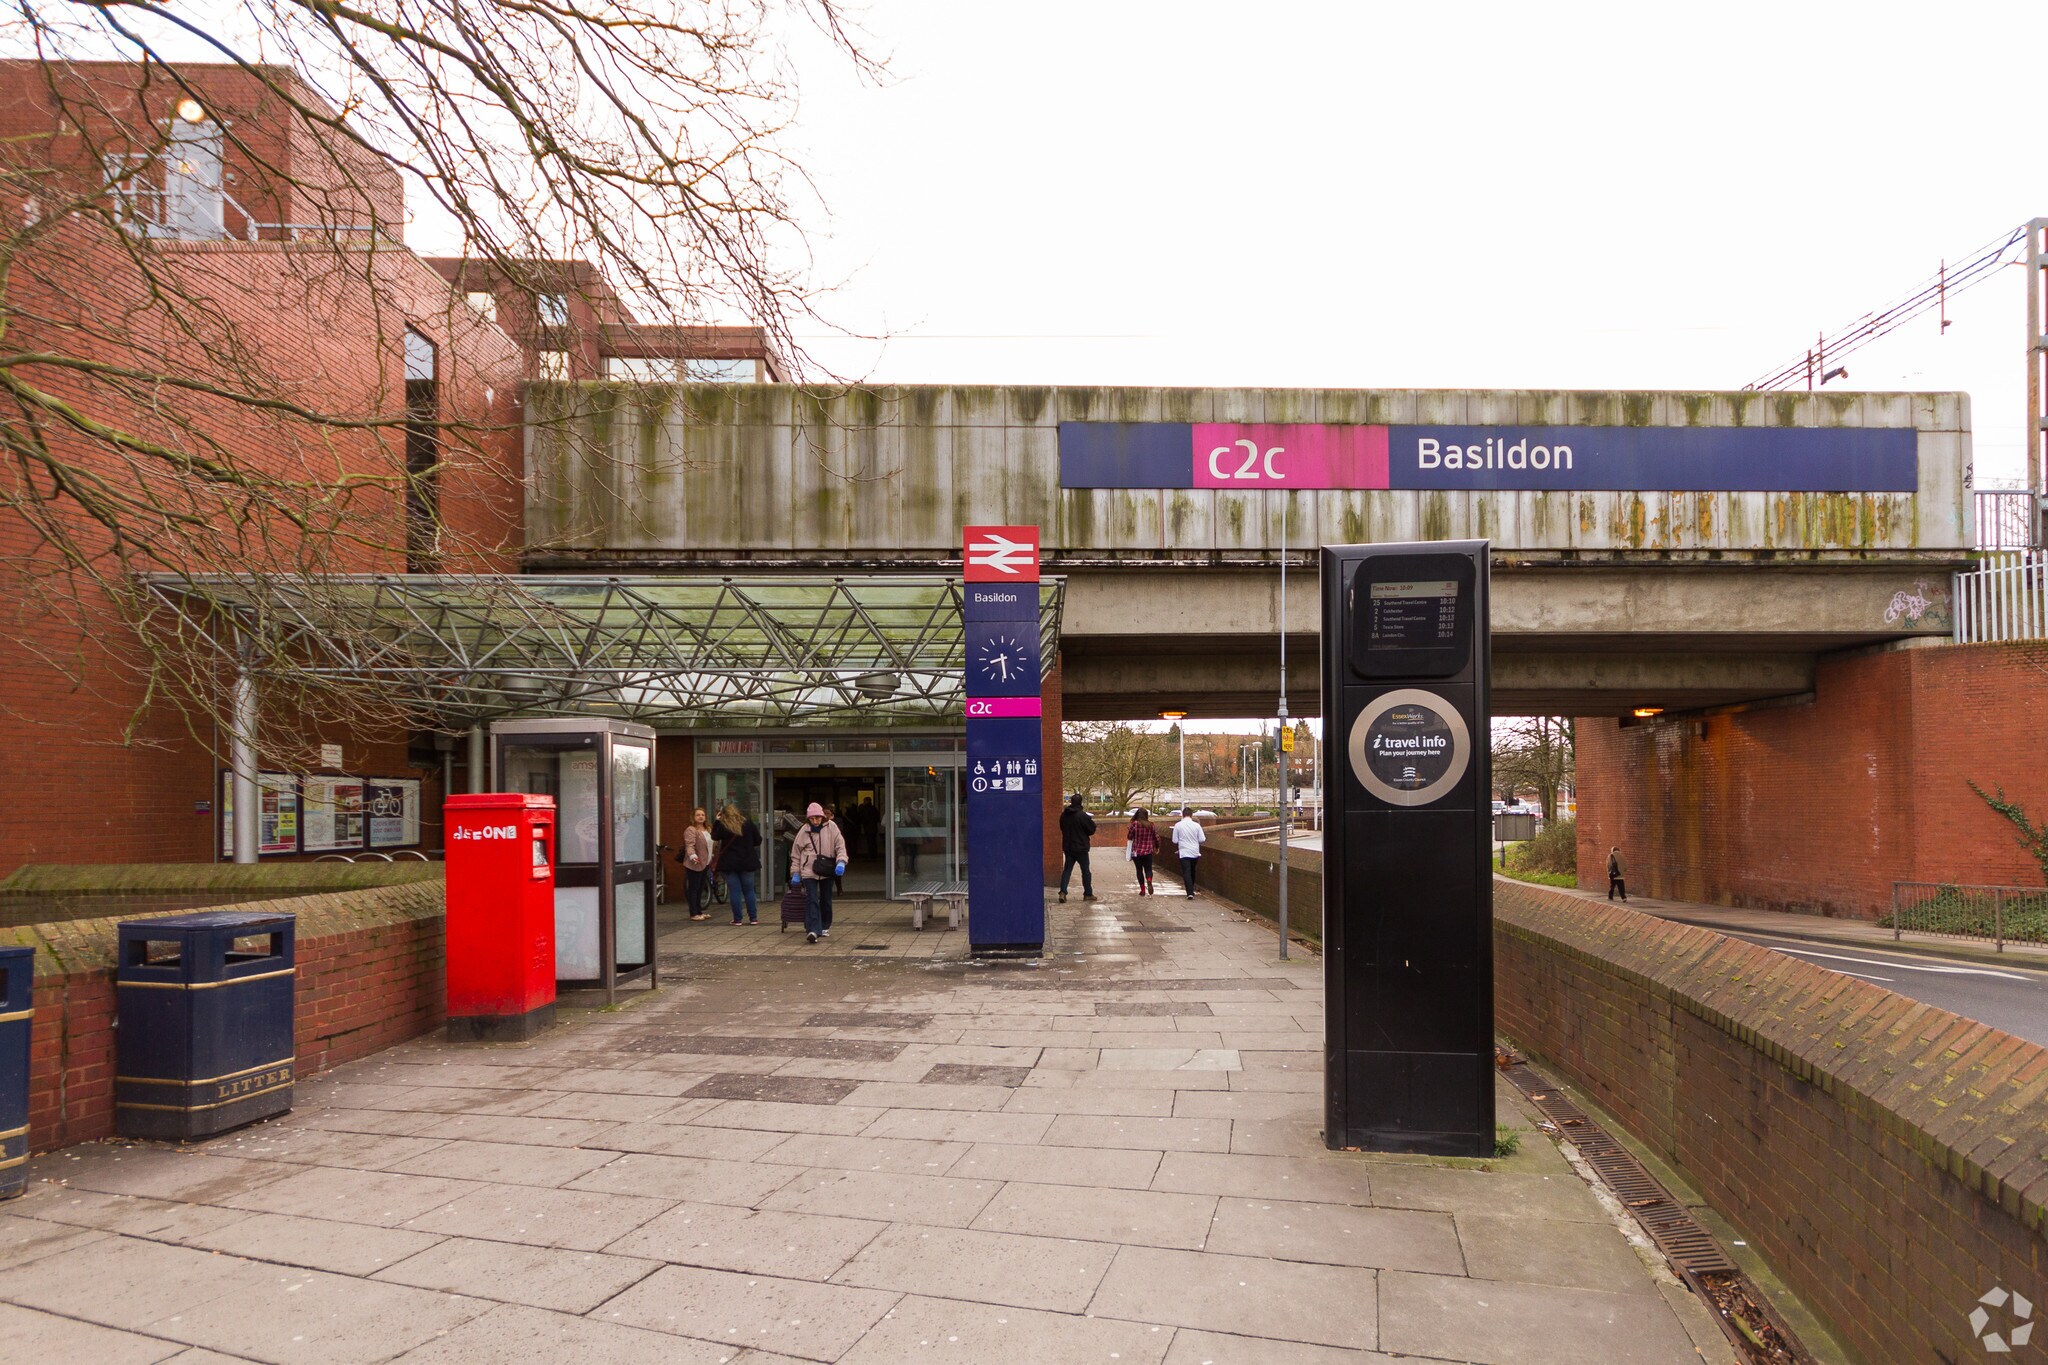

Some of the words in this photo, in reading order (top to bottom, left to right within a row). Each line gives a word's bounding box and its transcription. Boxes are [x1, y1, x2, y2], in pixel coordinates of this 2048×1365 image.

[1208, 440, 1286, 480] c2c
[1417, 437, 1573, 470] Basildon
[974, 592, 1017, 602] Basildon
[969, 702, 993, 715] c2c
[1385, 736, 1420, 748] travel
[1422, 736, 1446, 748] info
[1406, 749, 1427, 757] journey
[218, 1069, 290, 1098] LITTER
